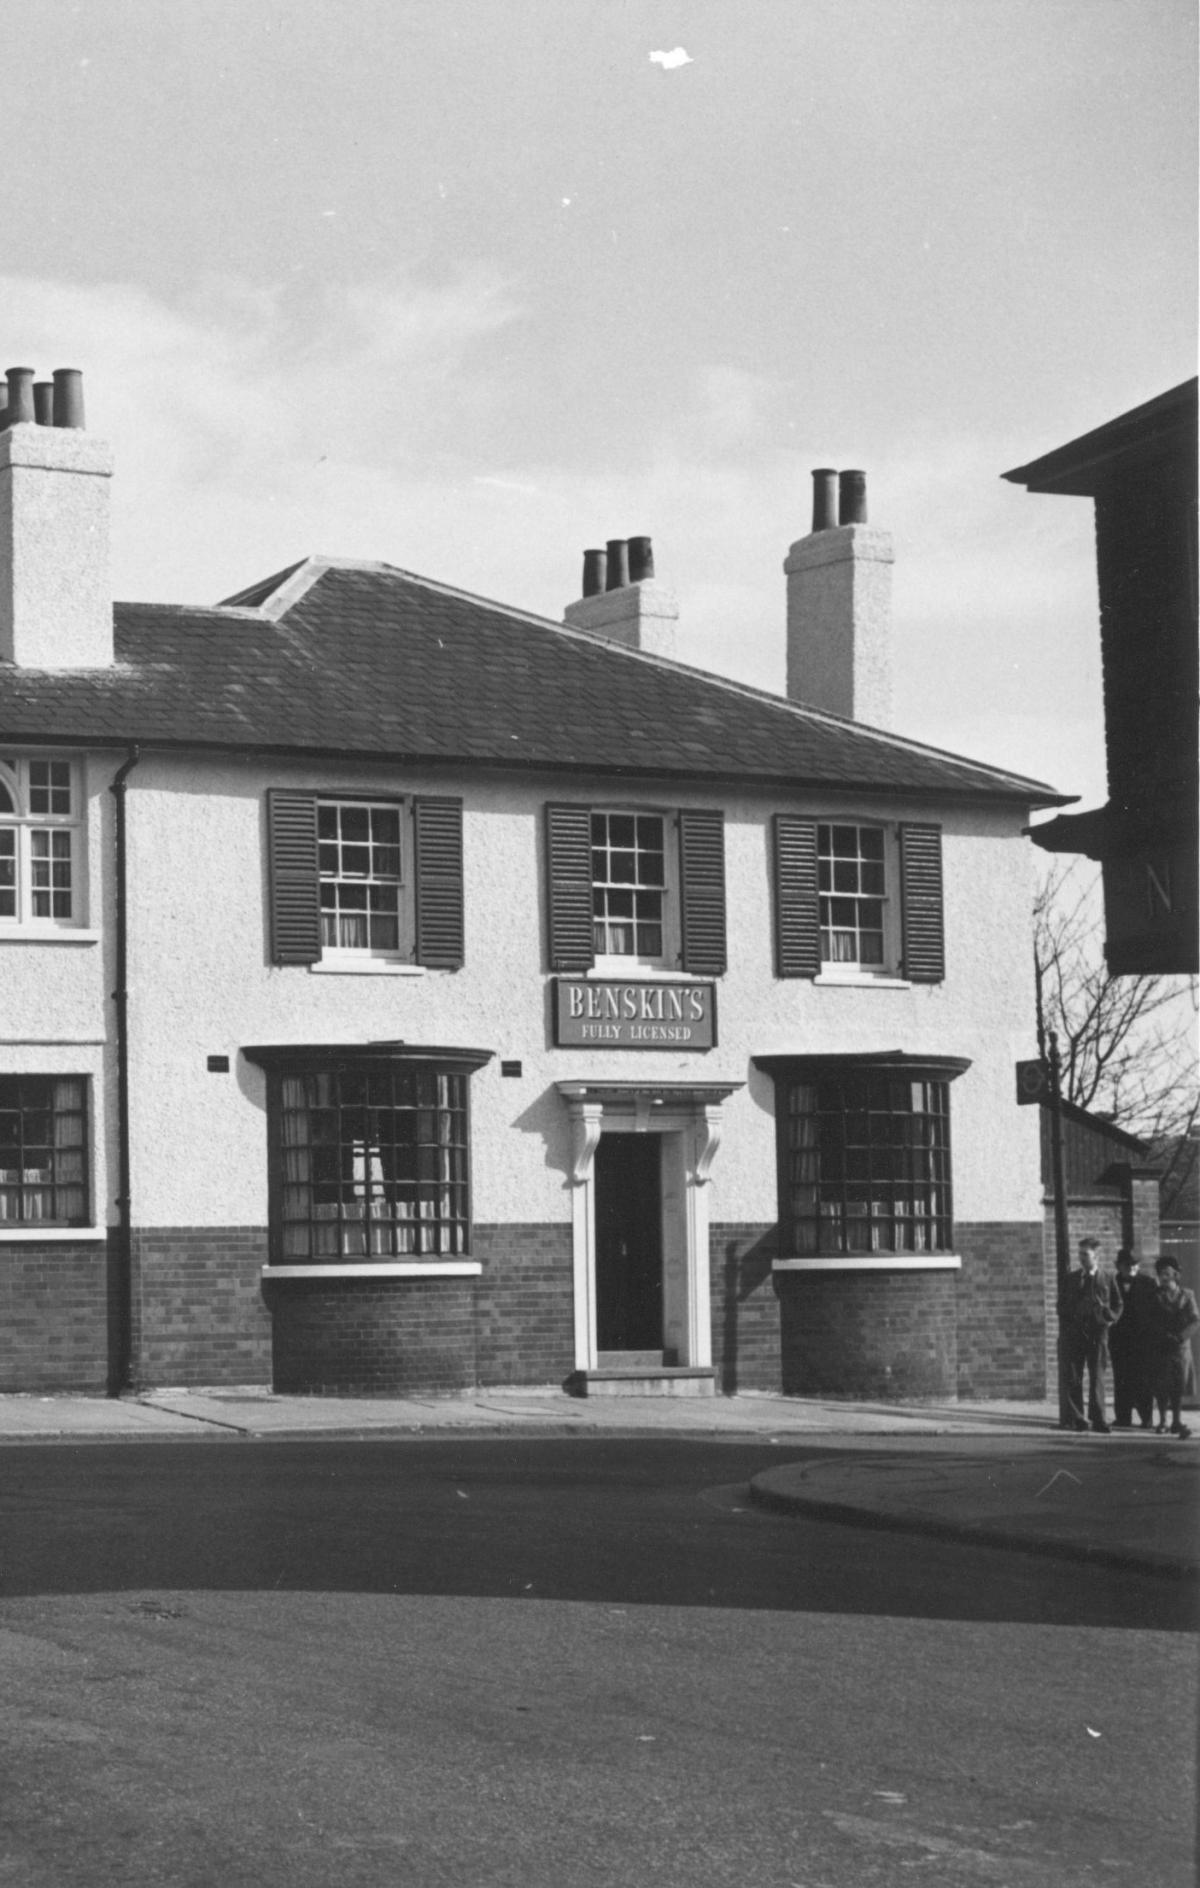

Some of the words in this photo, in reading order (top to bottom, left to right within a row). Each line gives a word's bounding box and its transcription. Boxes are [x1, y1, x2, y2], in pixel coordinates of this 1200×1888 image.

[569, 986, 704, 1021] BENSKIN'S
[582, 1024, 621, 1039] FULLY
[630, 1025, 692, 1041] LICENSED
